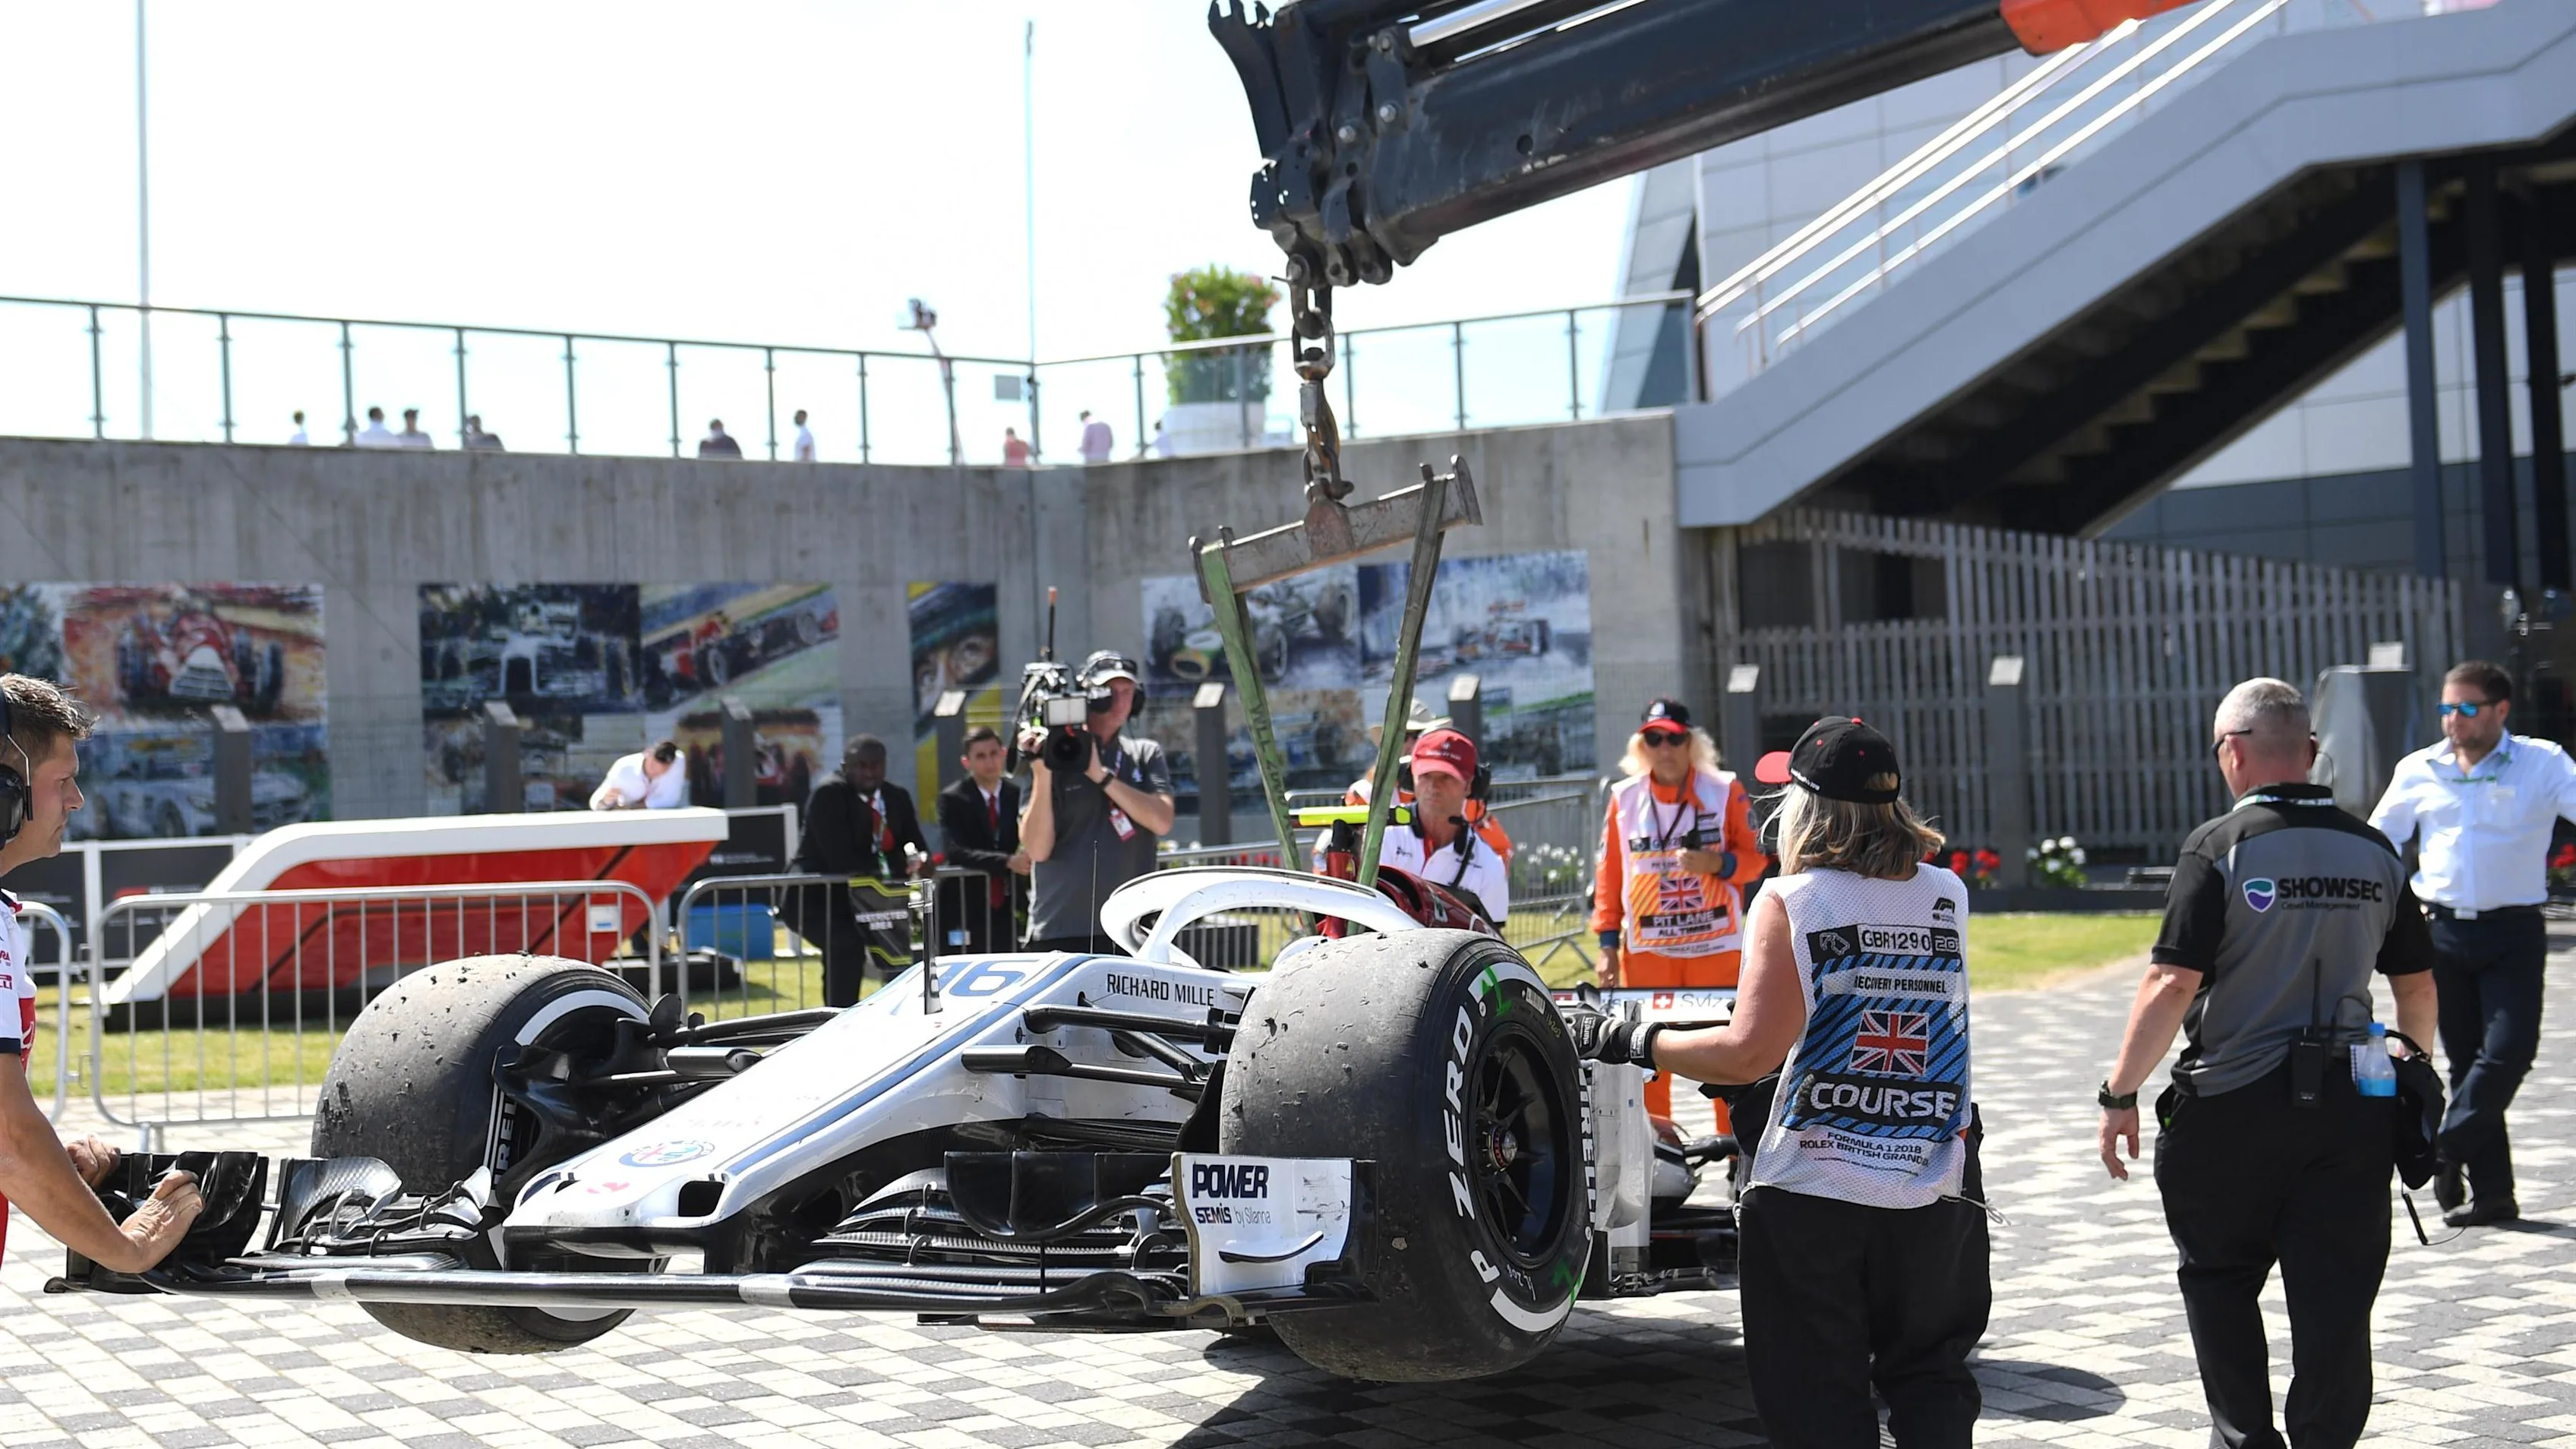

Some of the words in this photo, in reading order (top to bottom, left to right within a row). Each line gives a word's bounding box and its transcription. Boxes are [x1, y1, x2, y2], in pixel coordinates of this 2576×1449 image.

[2278, 877, 2382, 903] SHOWSEC
[1653, 915, 1674, 927] PIT
[1676, 911, 1715, 926] LANE
[1107, 974, 1170, 1001] RICHARD
[1175, 983, 1215, 1006] MILLE
[1894, 979, 1947, 994] PERSONNEL
[1443, 1005, 1476, 1220] ZERO
[1810, 1082, 1956, 1122] COURSE
[1800, 1140, 1835, 1149] ROLEX
[1836, 1142, 1881, 1159] BRITISH
[1827, 1132, 1886, 1152] FORMULA
[1894, 1144, 1922, 1154] 2018
[1192, 1163, 1270, 1198] POWER
[1234, 1206, 1245, 1228] by
